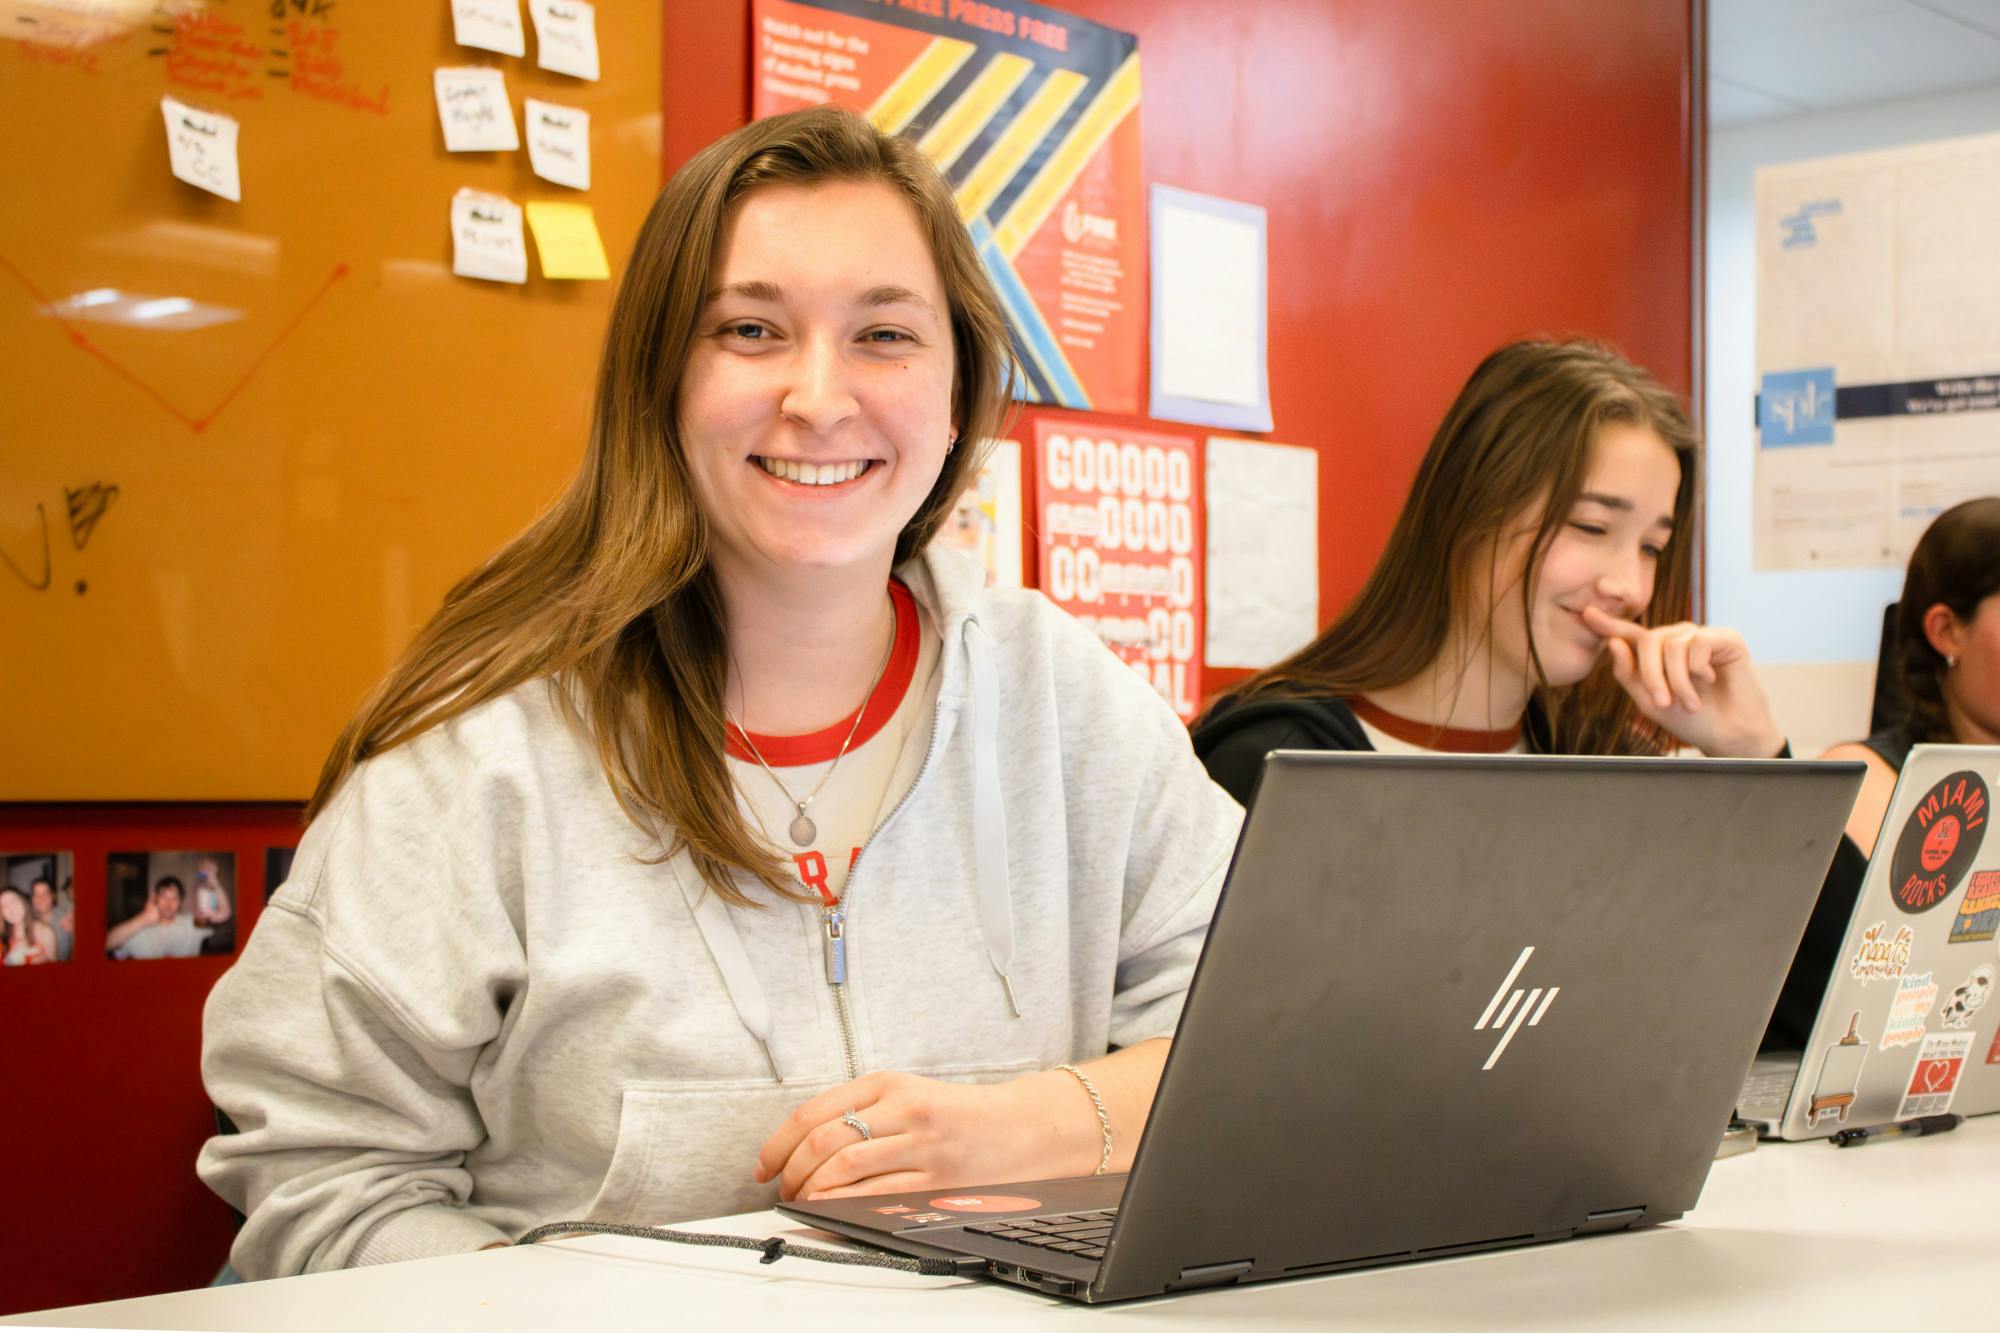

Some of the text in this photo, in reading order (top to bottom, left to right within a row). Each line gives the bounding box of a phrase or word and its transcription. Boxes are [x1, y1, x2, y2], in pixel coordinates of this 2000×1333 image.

[948, 0, 1016, 37] PRESS
[1018, 15, 1068, 51] FREE
[1917, 779, 1985, 831] MIAMI
[1900, 873, 1946, 907] ROCKS
[1474, 946, 1561, 1070] hp
